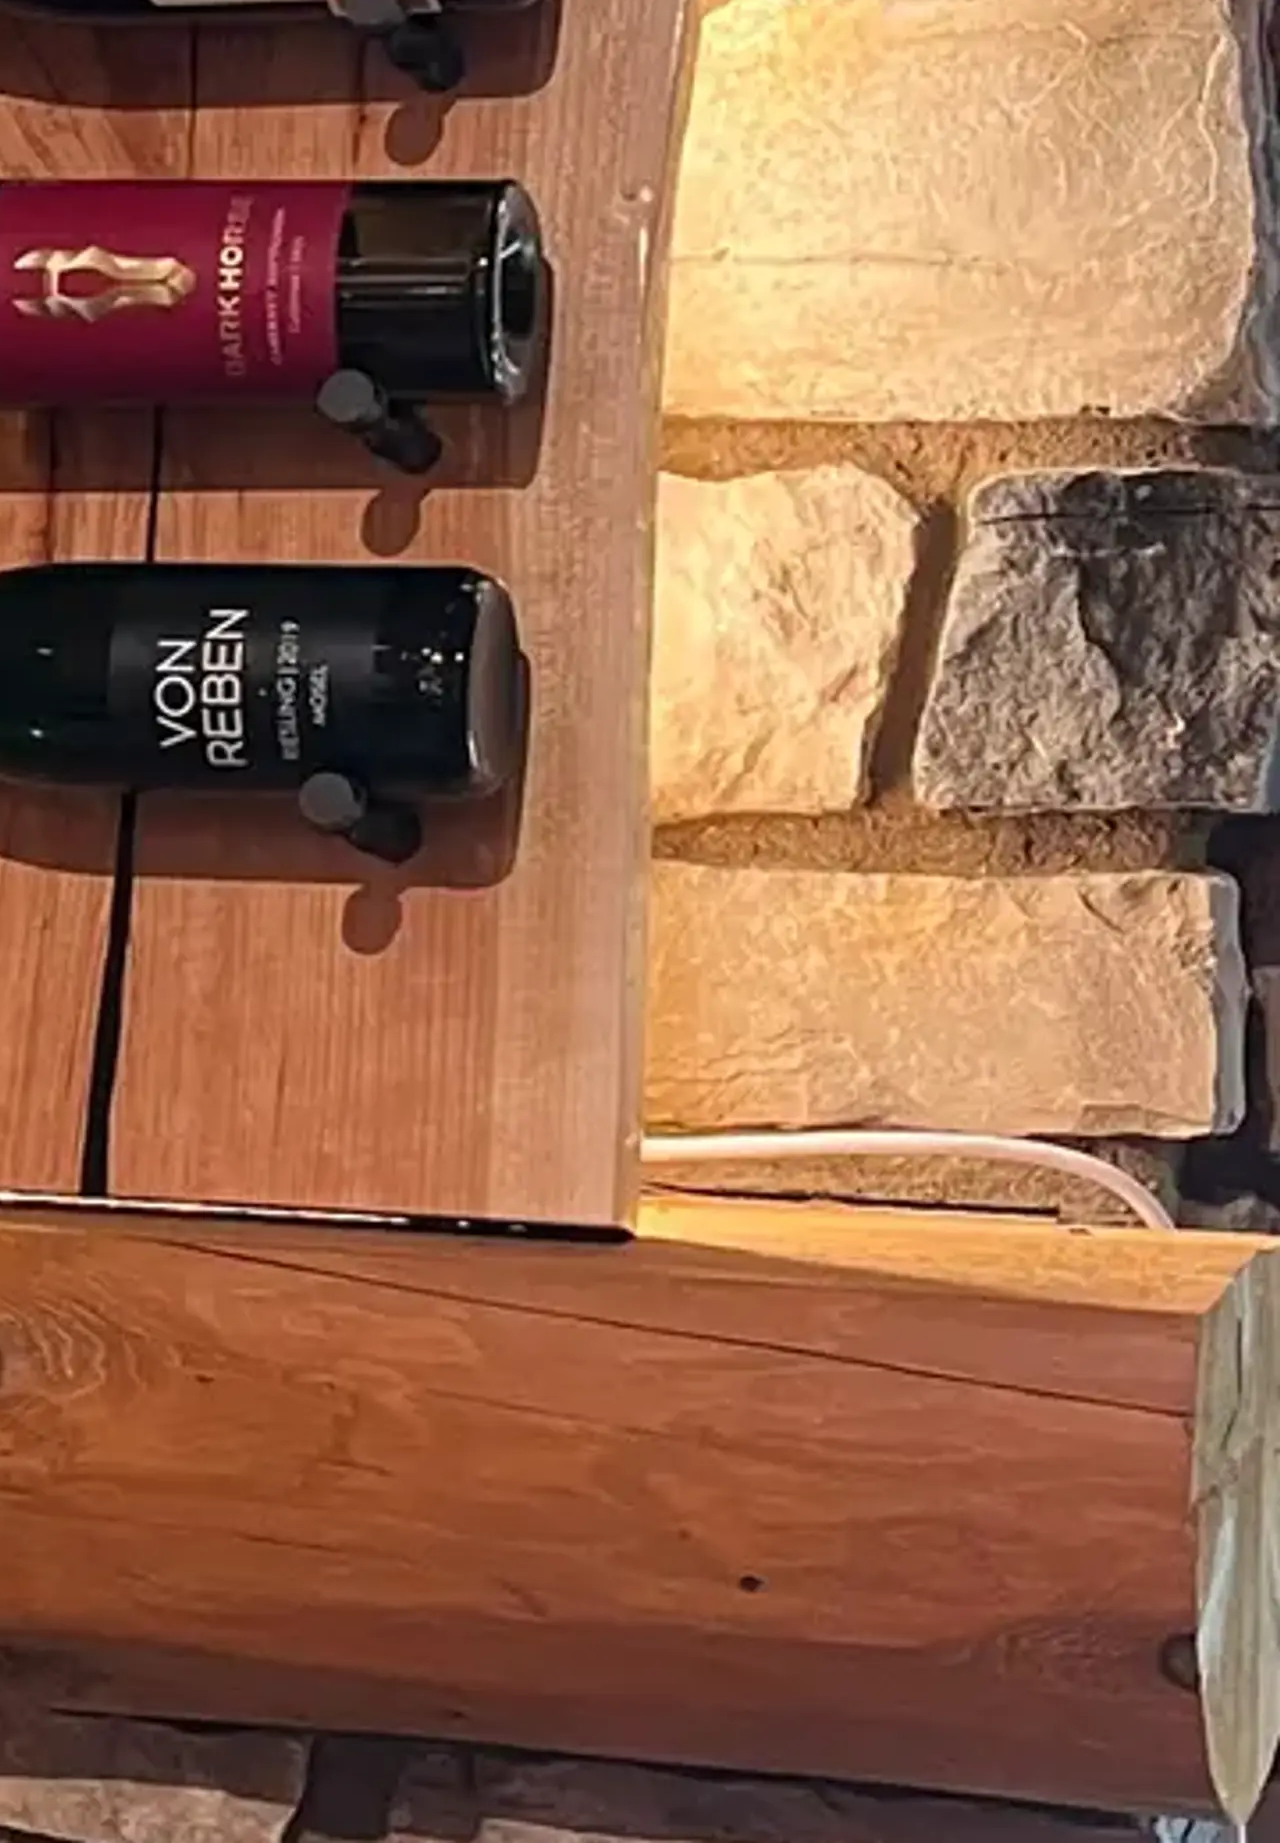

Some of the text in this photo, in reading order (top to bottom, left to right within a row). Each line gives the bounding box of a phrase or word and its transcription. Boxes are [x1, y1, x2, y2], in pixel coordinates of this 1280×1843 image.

[218, 195, 255, 377] DARK HORSE
[153, 639, 198, 748] VON
[201, 607, 249, 768] REBEN
[275, 676, 301, 761] RIESLING
[308, 665, 328, 727] MOSEL
